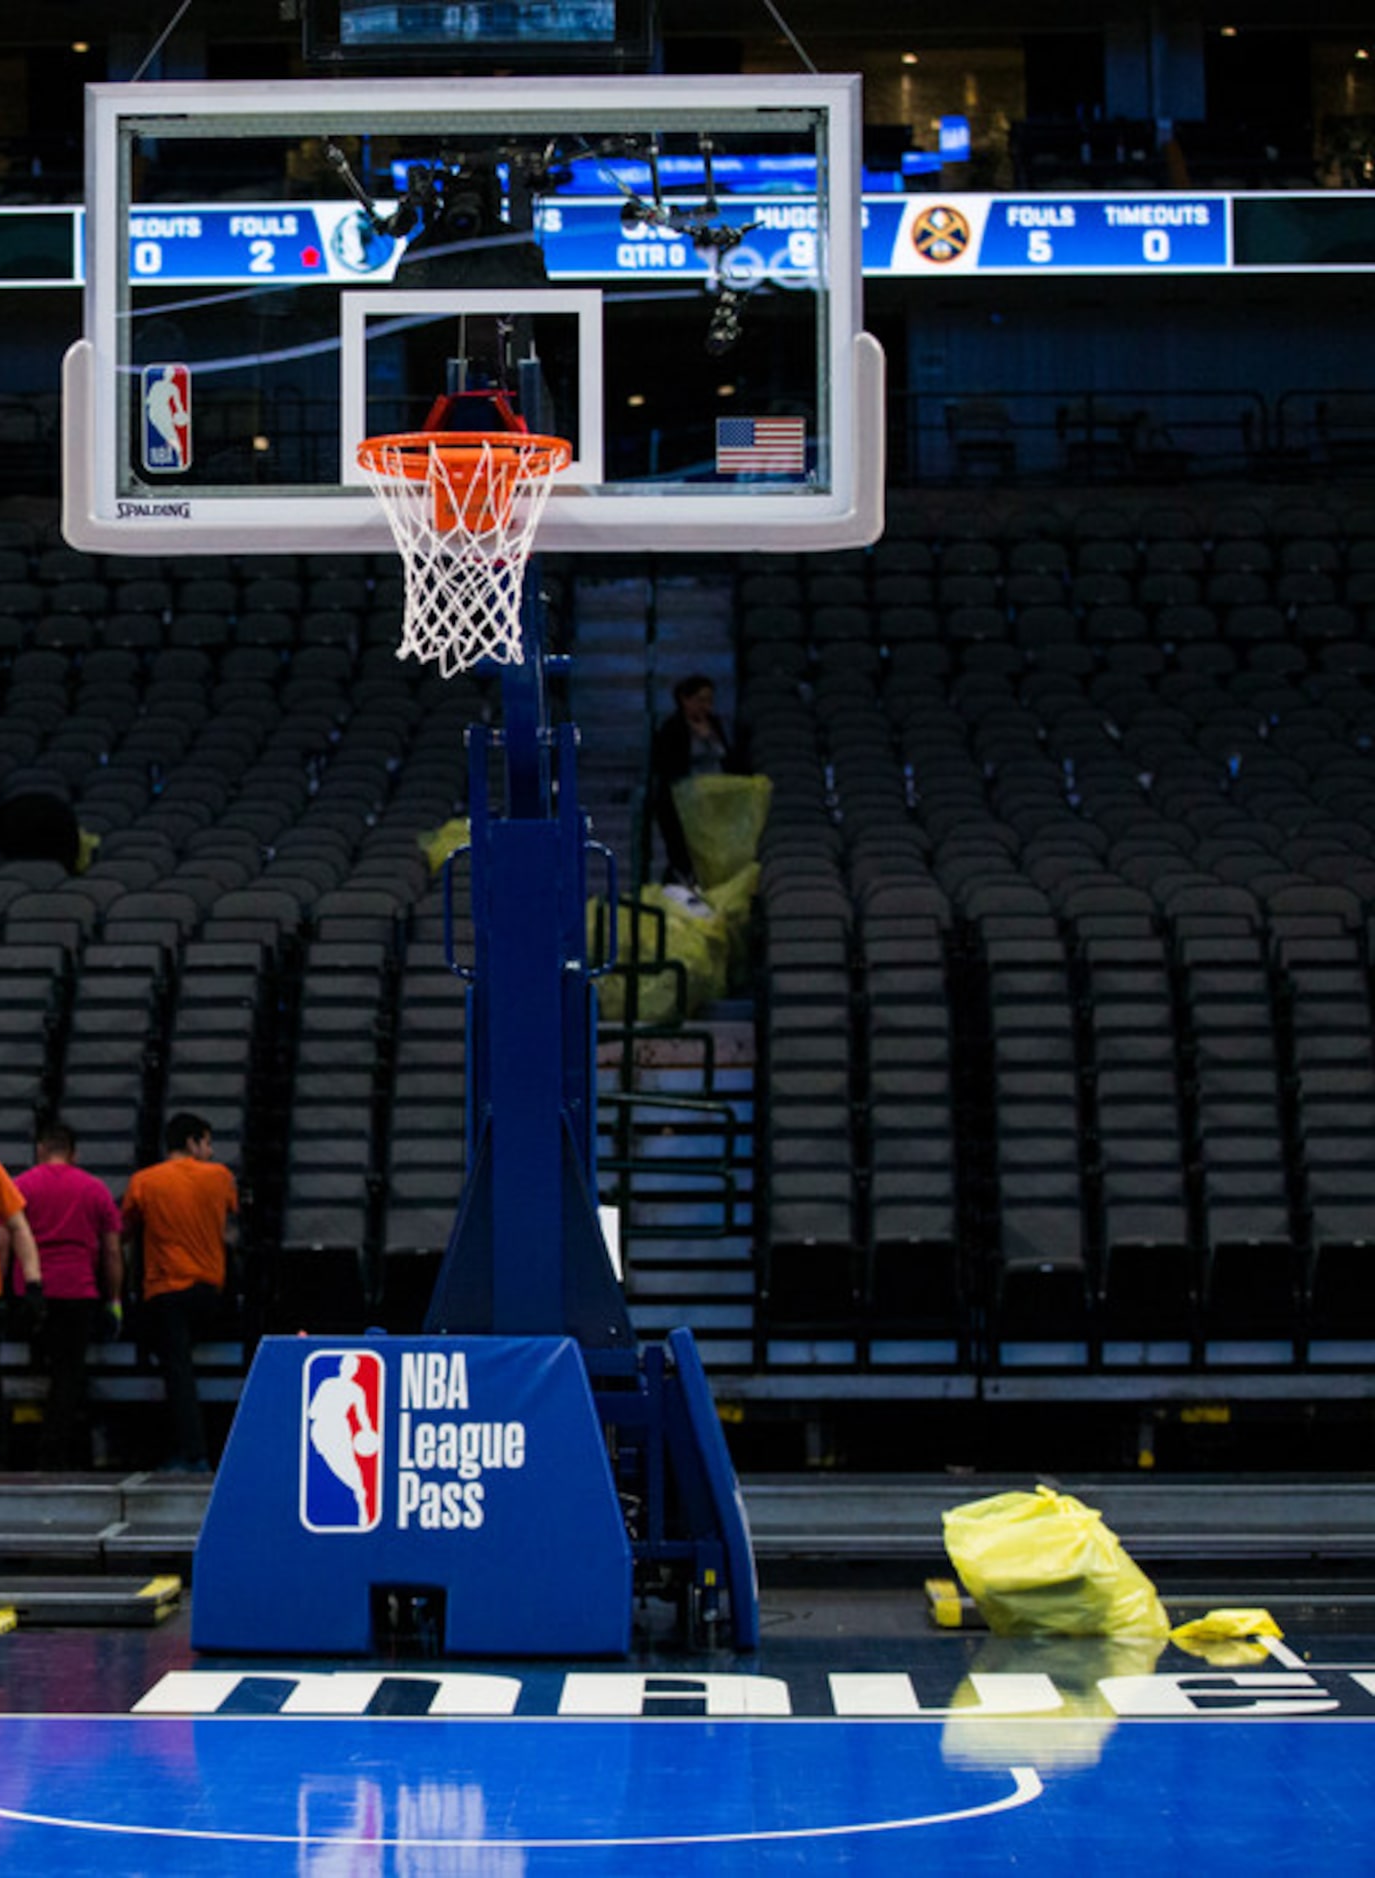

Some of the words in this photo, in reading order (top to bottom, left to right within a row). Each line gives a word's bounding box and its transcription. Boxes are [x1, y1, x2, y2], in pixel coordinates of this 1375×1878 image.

[229, 214, 299, 236] FOULS
[754, 205, 870, 230] NUGGS
[1006, 205, 1076, 228] FOULS
[1104, 205, 1210, 227] TIMEOUTS
[134, 241, 162, 275] 0
[248, 240, 276, 273] 2
[616, 243, 666, 269] QTR
[1027, 230, 1053, 263] 5
[1142, 229, 1171, 263] 0
[115, 502, 191, 519] SPALDING
[399, 1351, 470, 1410] NBA
[398, 1411, 526, 1480] League
[397, 1470, 485, 1530] Pass
[129, 1670, 1375, 1716] MAVE
